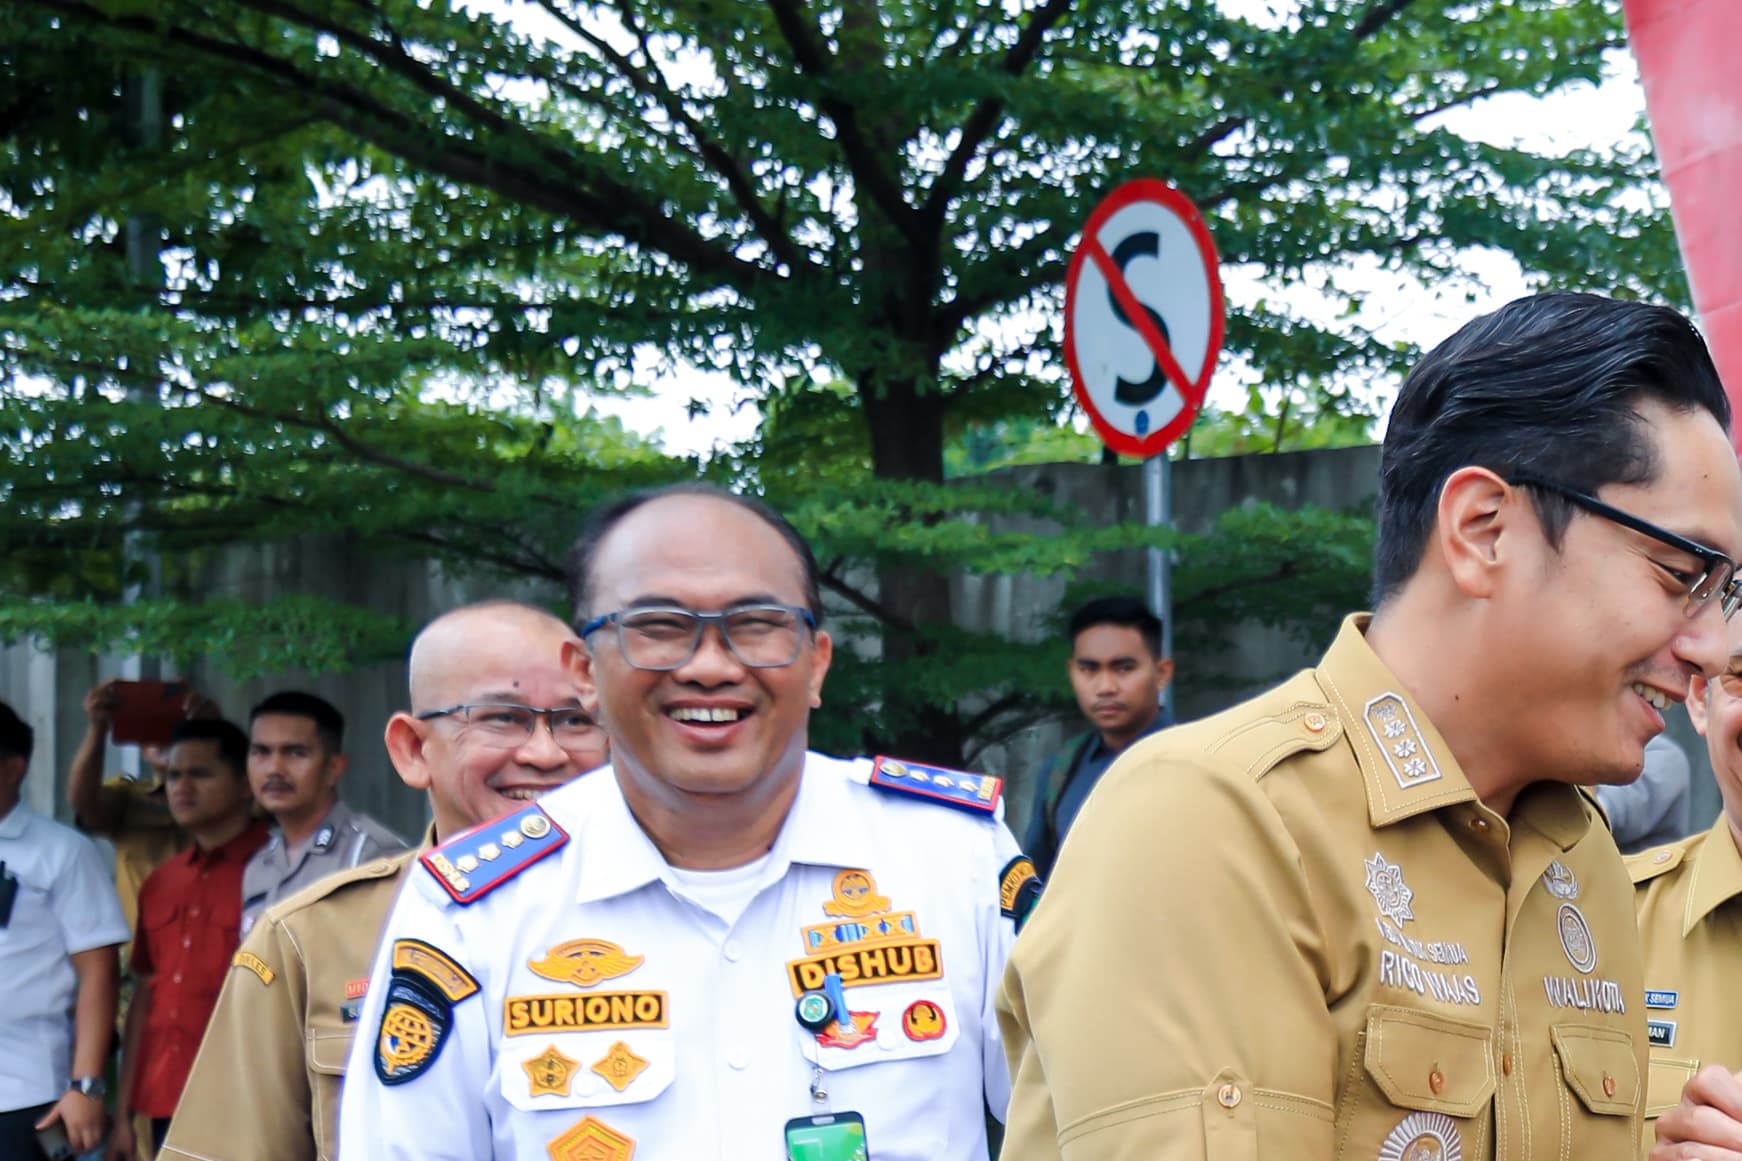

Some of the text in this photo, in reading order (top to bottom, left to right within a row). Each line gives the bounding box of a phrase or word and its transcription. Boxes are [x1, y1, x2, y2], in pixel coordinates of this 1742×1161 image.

[1107, 232, 1170, 406] S
[799, 945, 936, 990] DISHUB
[1380, 950, 1425, 996] RICO
[511, 995, 660, 1029] SURIONO
